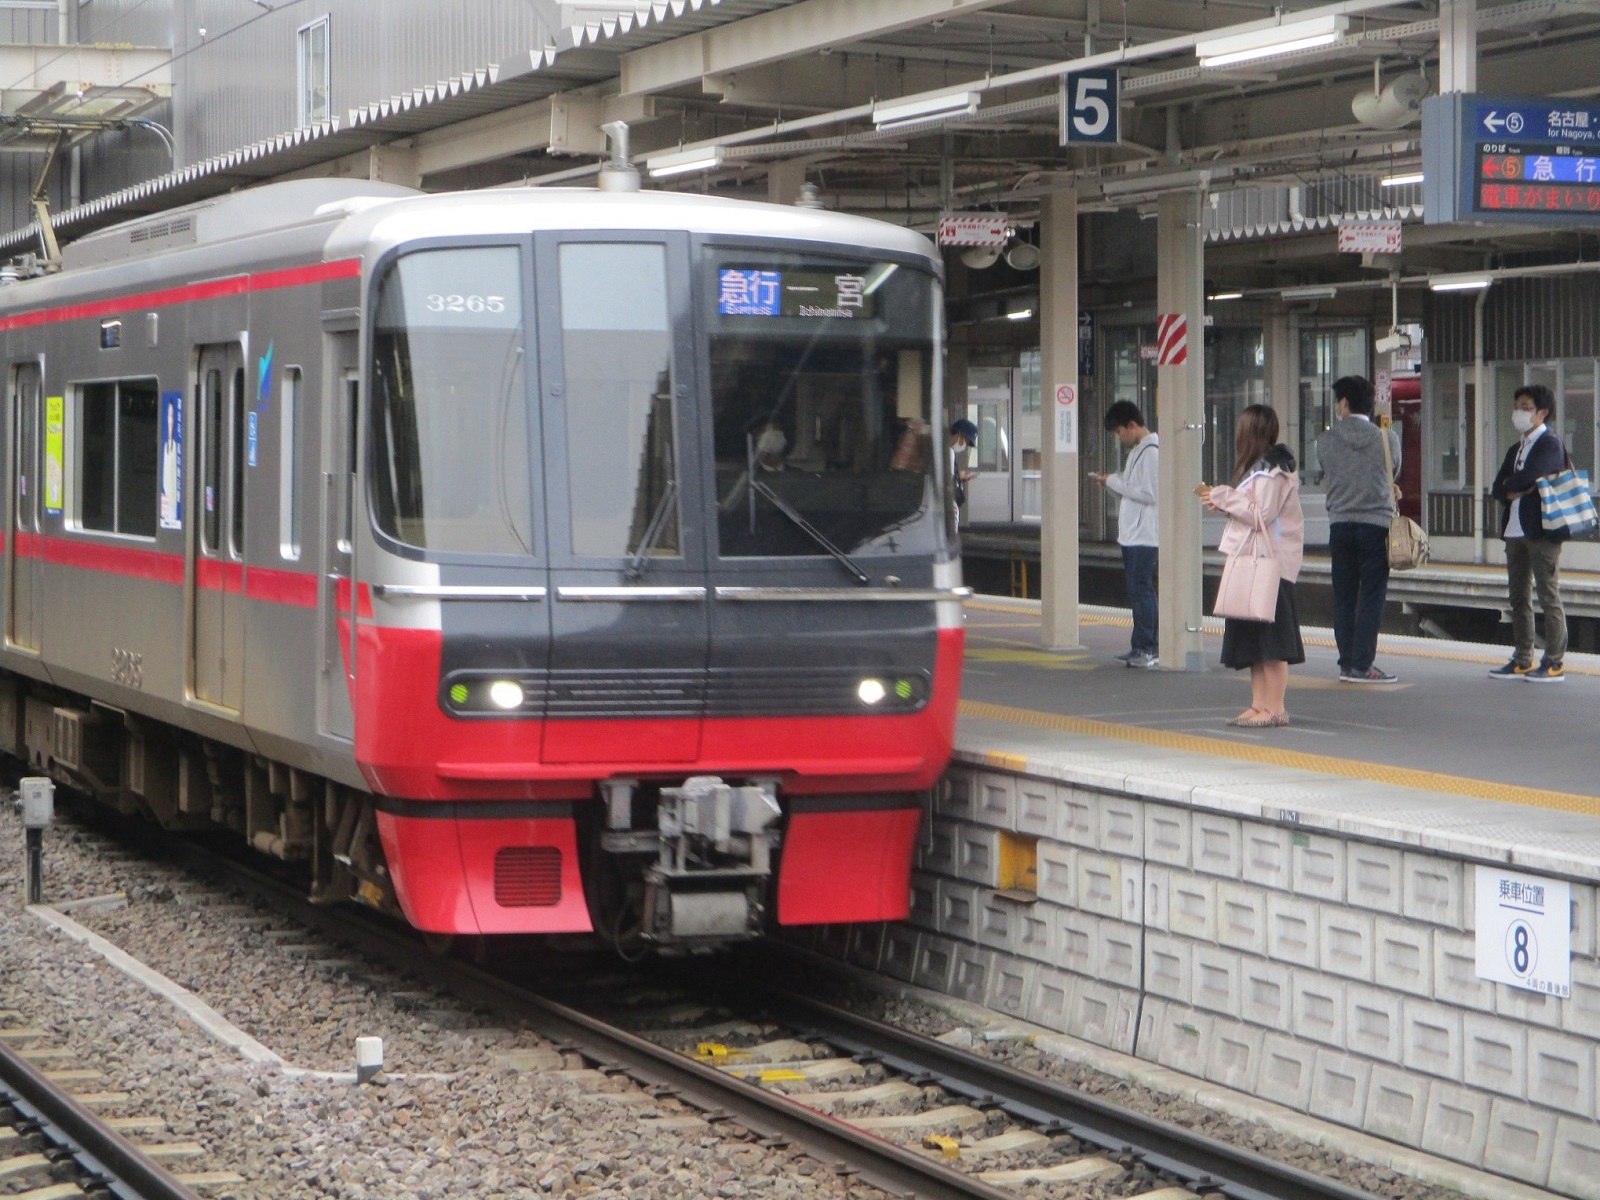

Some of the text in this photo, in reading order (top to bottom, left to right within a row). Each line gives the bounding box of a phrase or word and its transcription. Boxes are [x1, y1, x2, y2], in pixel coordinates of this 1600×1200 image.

[1073, 78, 1109, 136] 5
[1548, 129, 1559, 137] for
[1561, 129, 1595, 140] Nagoya,
[1483, 143, 1506, 153] のりば
[1533, 155, 1597, 182] 急行
[1482, 184, 1600, 210] 電車がまいり
[719, 269, 779, 304] 急行
[426, 293, 506, 313] 3265
[726, 303, 773, 315] Express
[1499, 879, 1544, 907] 乗車位置
[1513, 925, 1529, 973] 8
